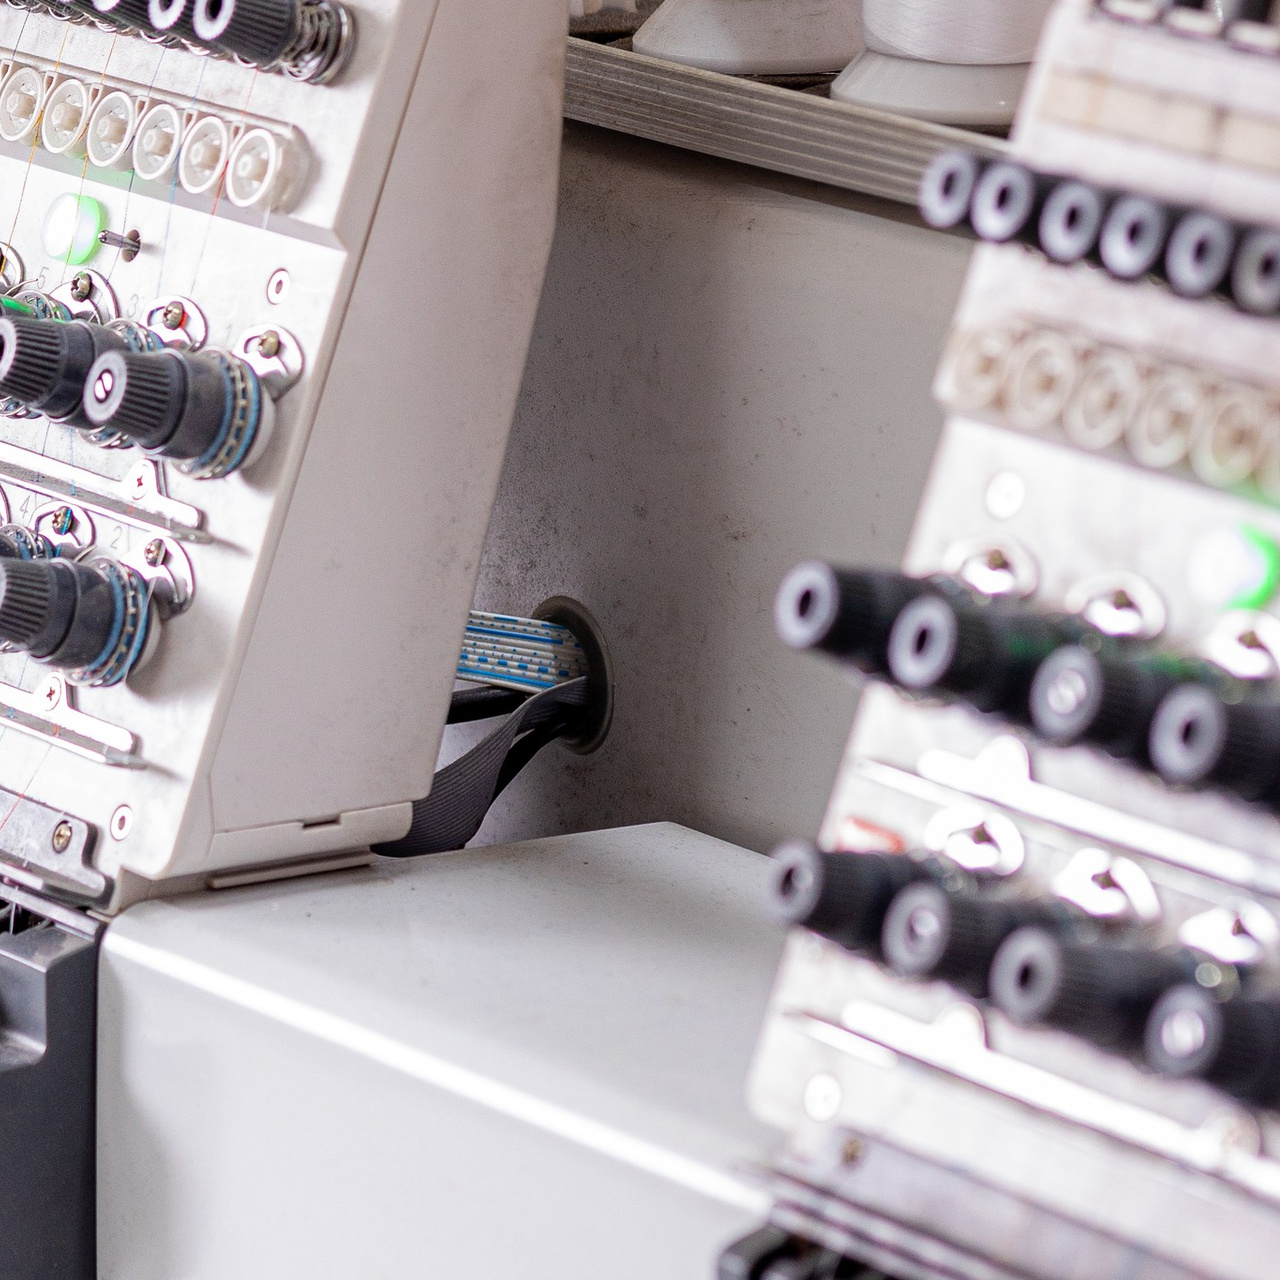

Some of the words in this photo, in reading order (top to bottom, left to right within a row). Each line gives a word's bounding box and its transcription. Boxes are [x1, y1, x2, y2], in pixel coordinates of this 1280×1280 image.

[36, 266, 50, 290] 5
[126, 293, 139, 319] 3
[19, 494, 31, 520] 4
[110, 525, 123, 550] 2
